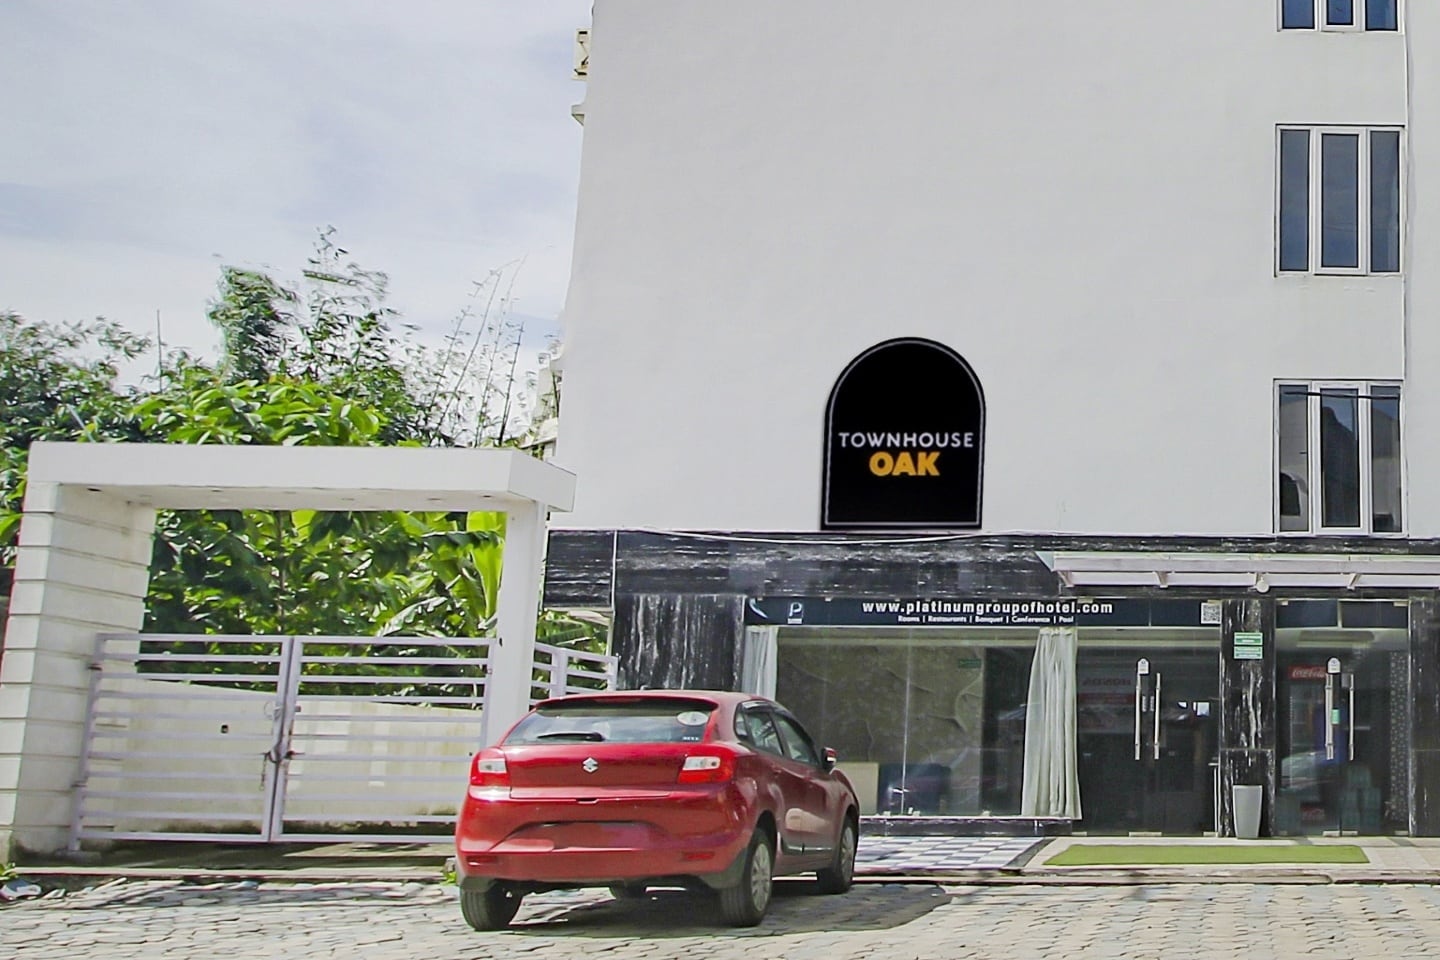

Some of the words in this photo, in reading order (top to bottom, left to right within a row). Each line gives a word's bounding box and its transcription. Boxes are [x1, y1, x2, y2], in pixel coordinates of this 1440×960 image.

[838, 431, 974, 449] TOWNHOUSE
[868, 451, 941, 478] OAK
[862, 600, 1113, 616] www.platinumgroupofhotel.com
[897, 615, 920, 623] Rooms
[928, 615, 967, 623] Restaurants
[974, 615, 1004, 624] Banquet
[1011, 615, 1050, 623] Conference
[1058, 615, 1074, 623] Pool
